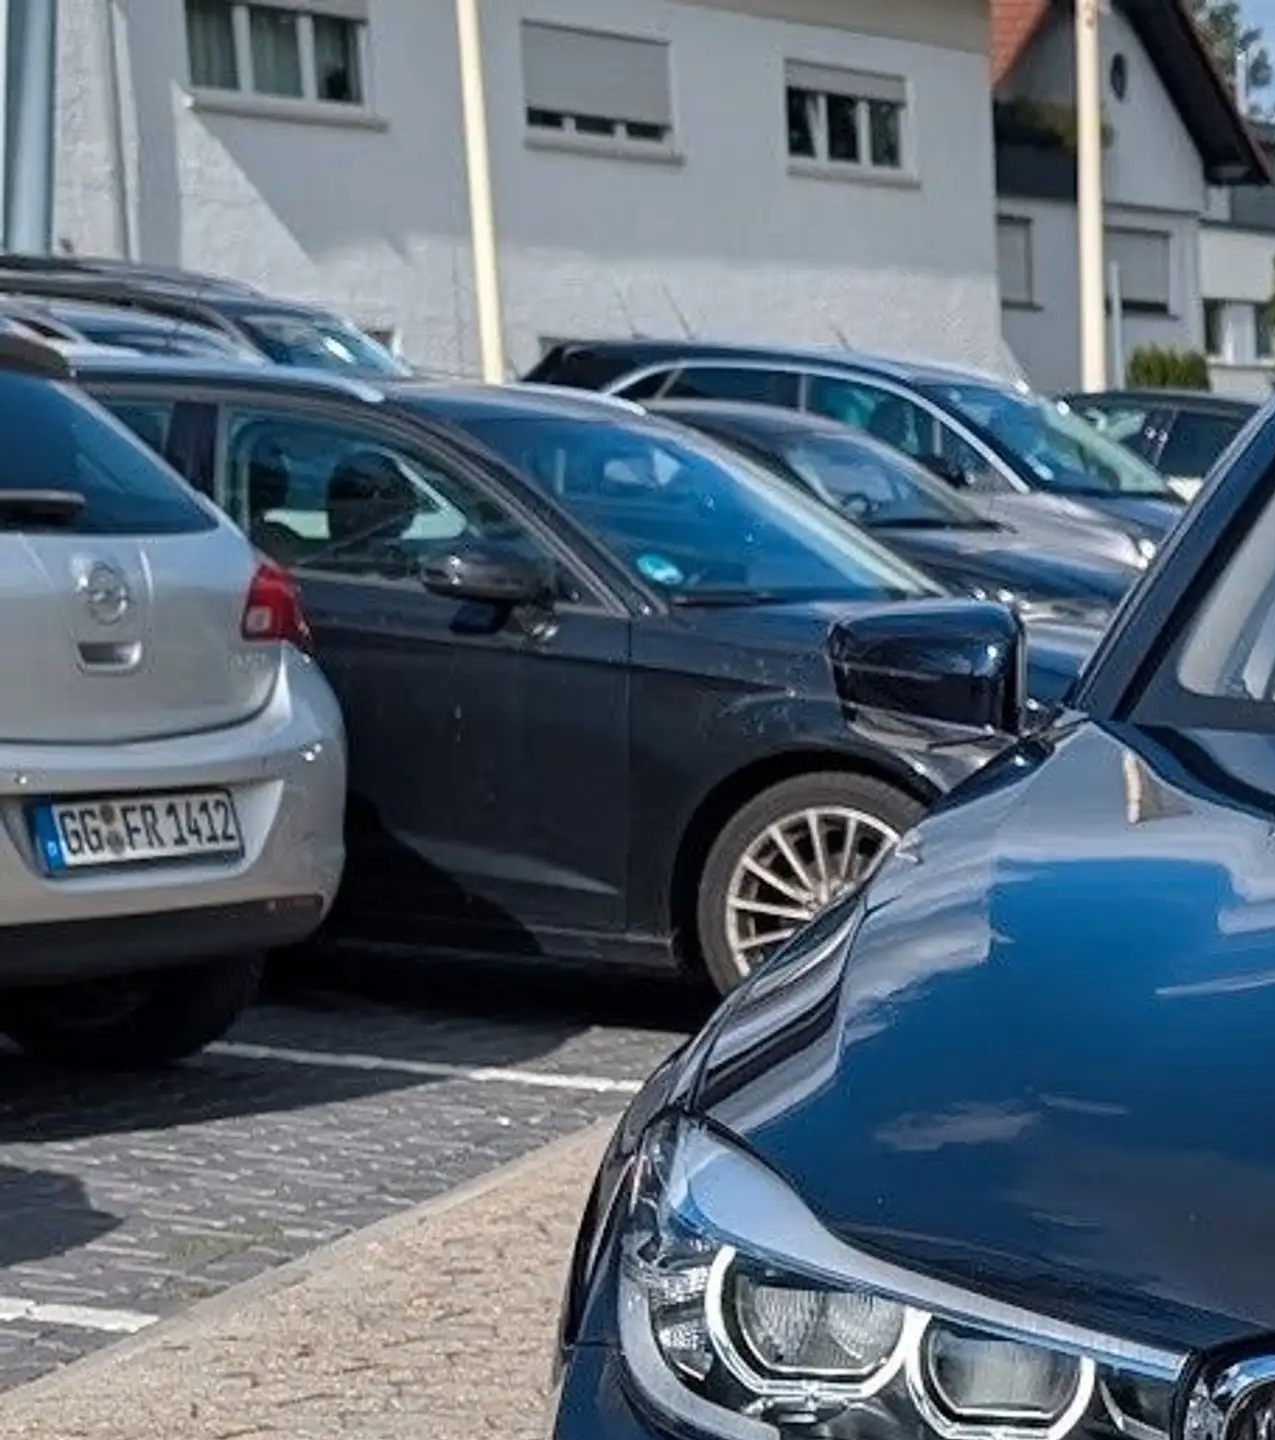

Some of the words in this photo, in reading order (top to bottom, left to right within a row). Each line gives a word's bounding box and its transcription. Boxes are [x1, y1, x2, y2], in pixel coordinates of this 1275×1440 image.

[58, 810, 103, 854] GG
[121, 803, 164, 850] FR
[166, 799, 235, 846] 1412
